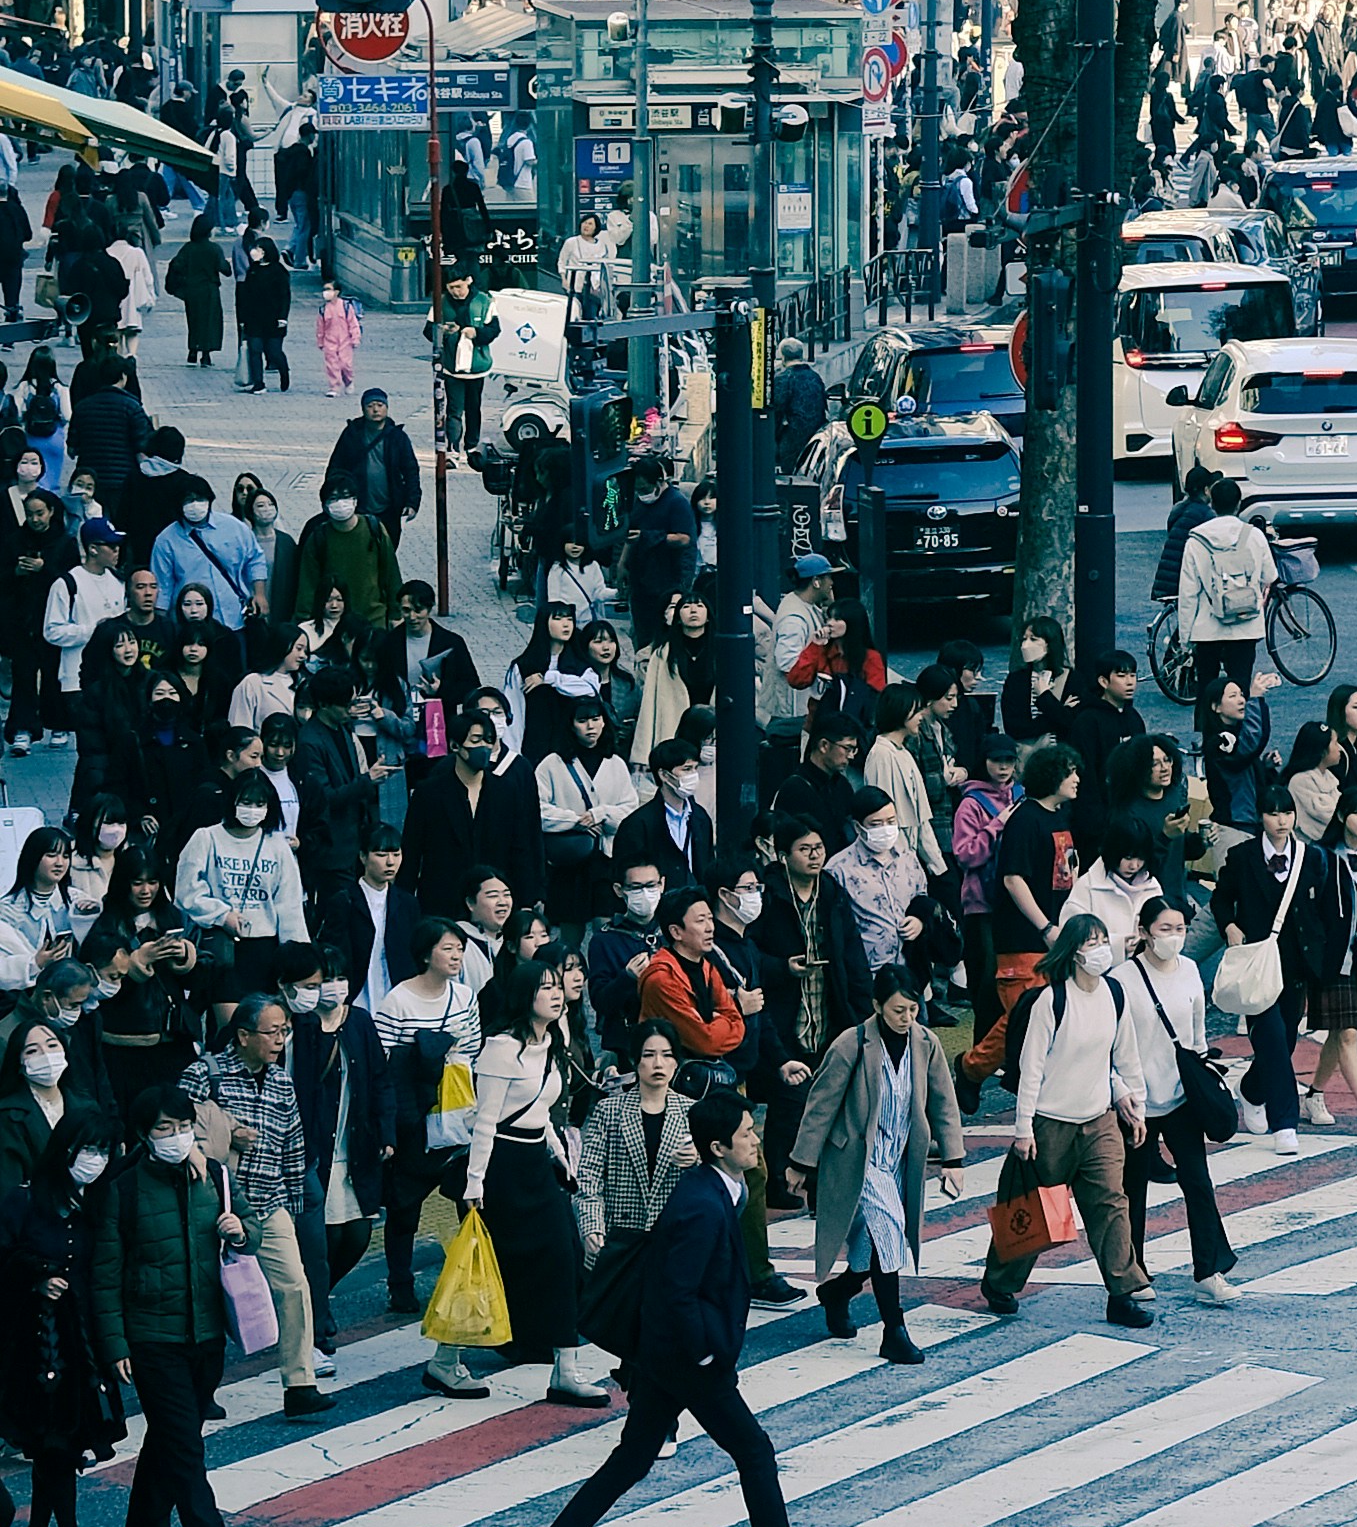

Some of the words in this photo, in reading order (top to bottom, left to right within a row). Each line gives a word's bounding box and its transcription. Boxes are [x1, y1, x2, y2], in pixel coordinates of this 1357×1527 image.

[340, 11, 405, 40] 消火栓
[346, 77, 428, 103] セキネ
